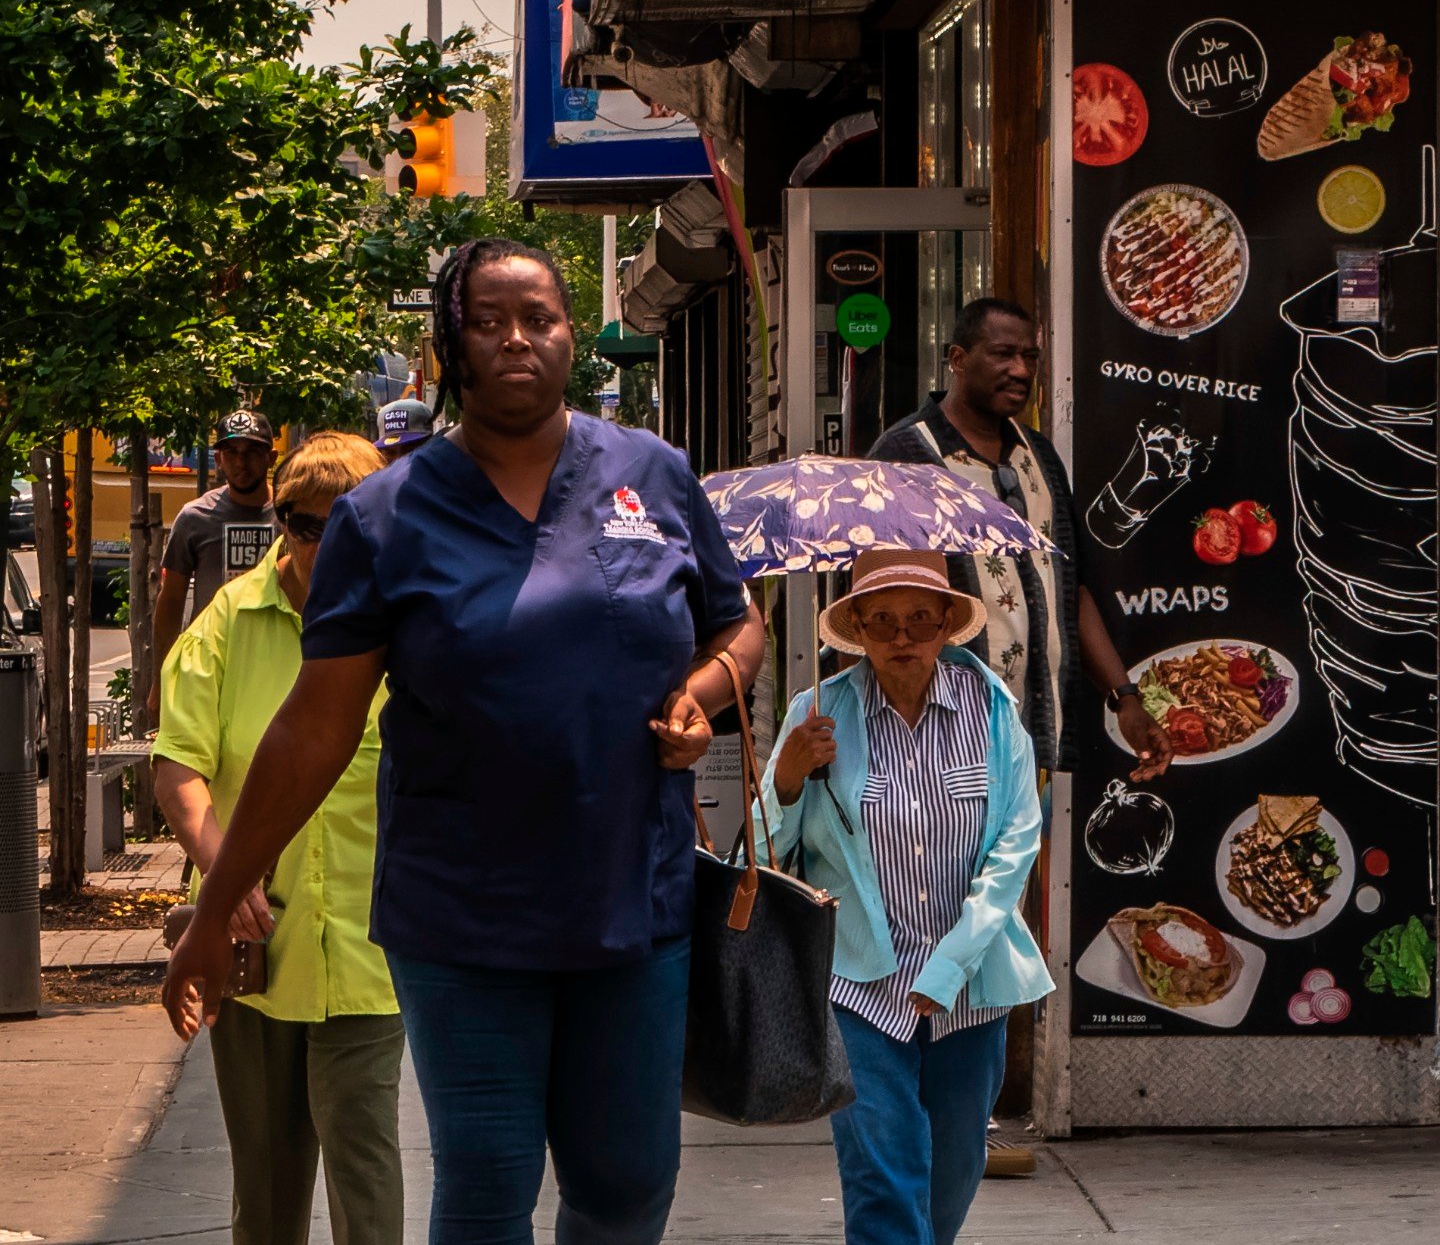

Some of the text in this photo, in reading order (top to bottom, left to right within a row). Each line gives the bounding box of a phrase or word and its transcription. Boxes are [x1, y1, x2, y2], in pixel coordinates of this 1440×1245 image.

[1182, 53, 1256, 94] HALAL
[848, 322, 878, 333] Eats
[1099, 360, 1263, 403] GYRO OVER RICE
[384, 410, 408, 421] CASH
[384, 421, 407, 430] ONLY
[827, 421, 840, 455] PU
[230, 530, 270, 545] MADE IN
[1115, 586, 1230, 616] WRAPS
[1092, 1014, 1107, 1023] 718
